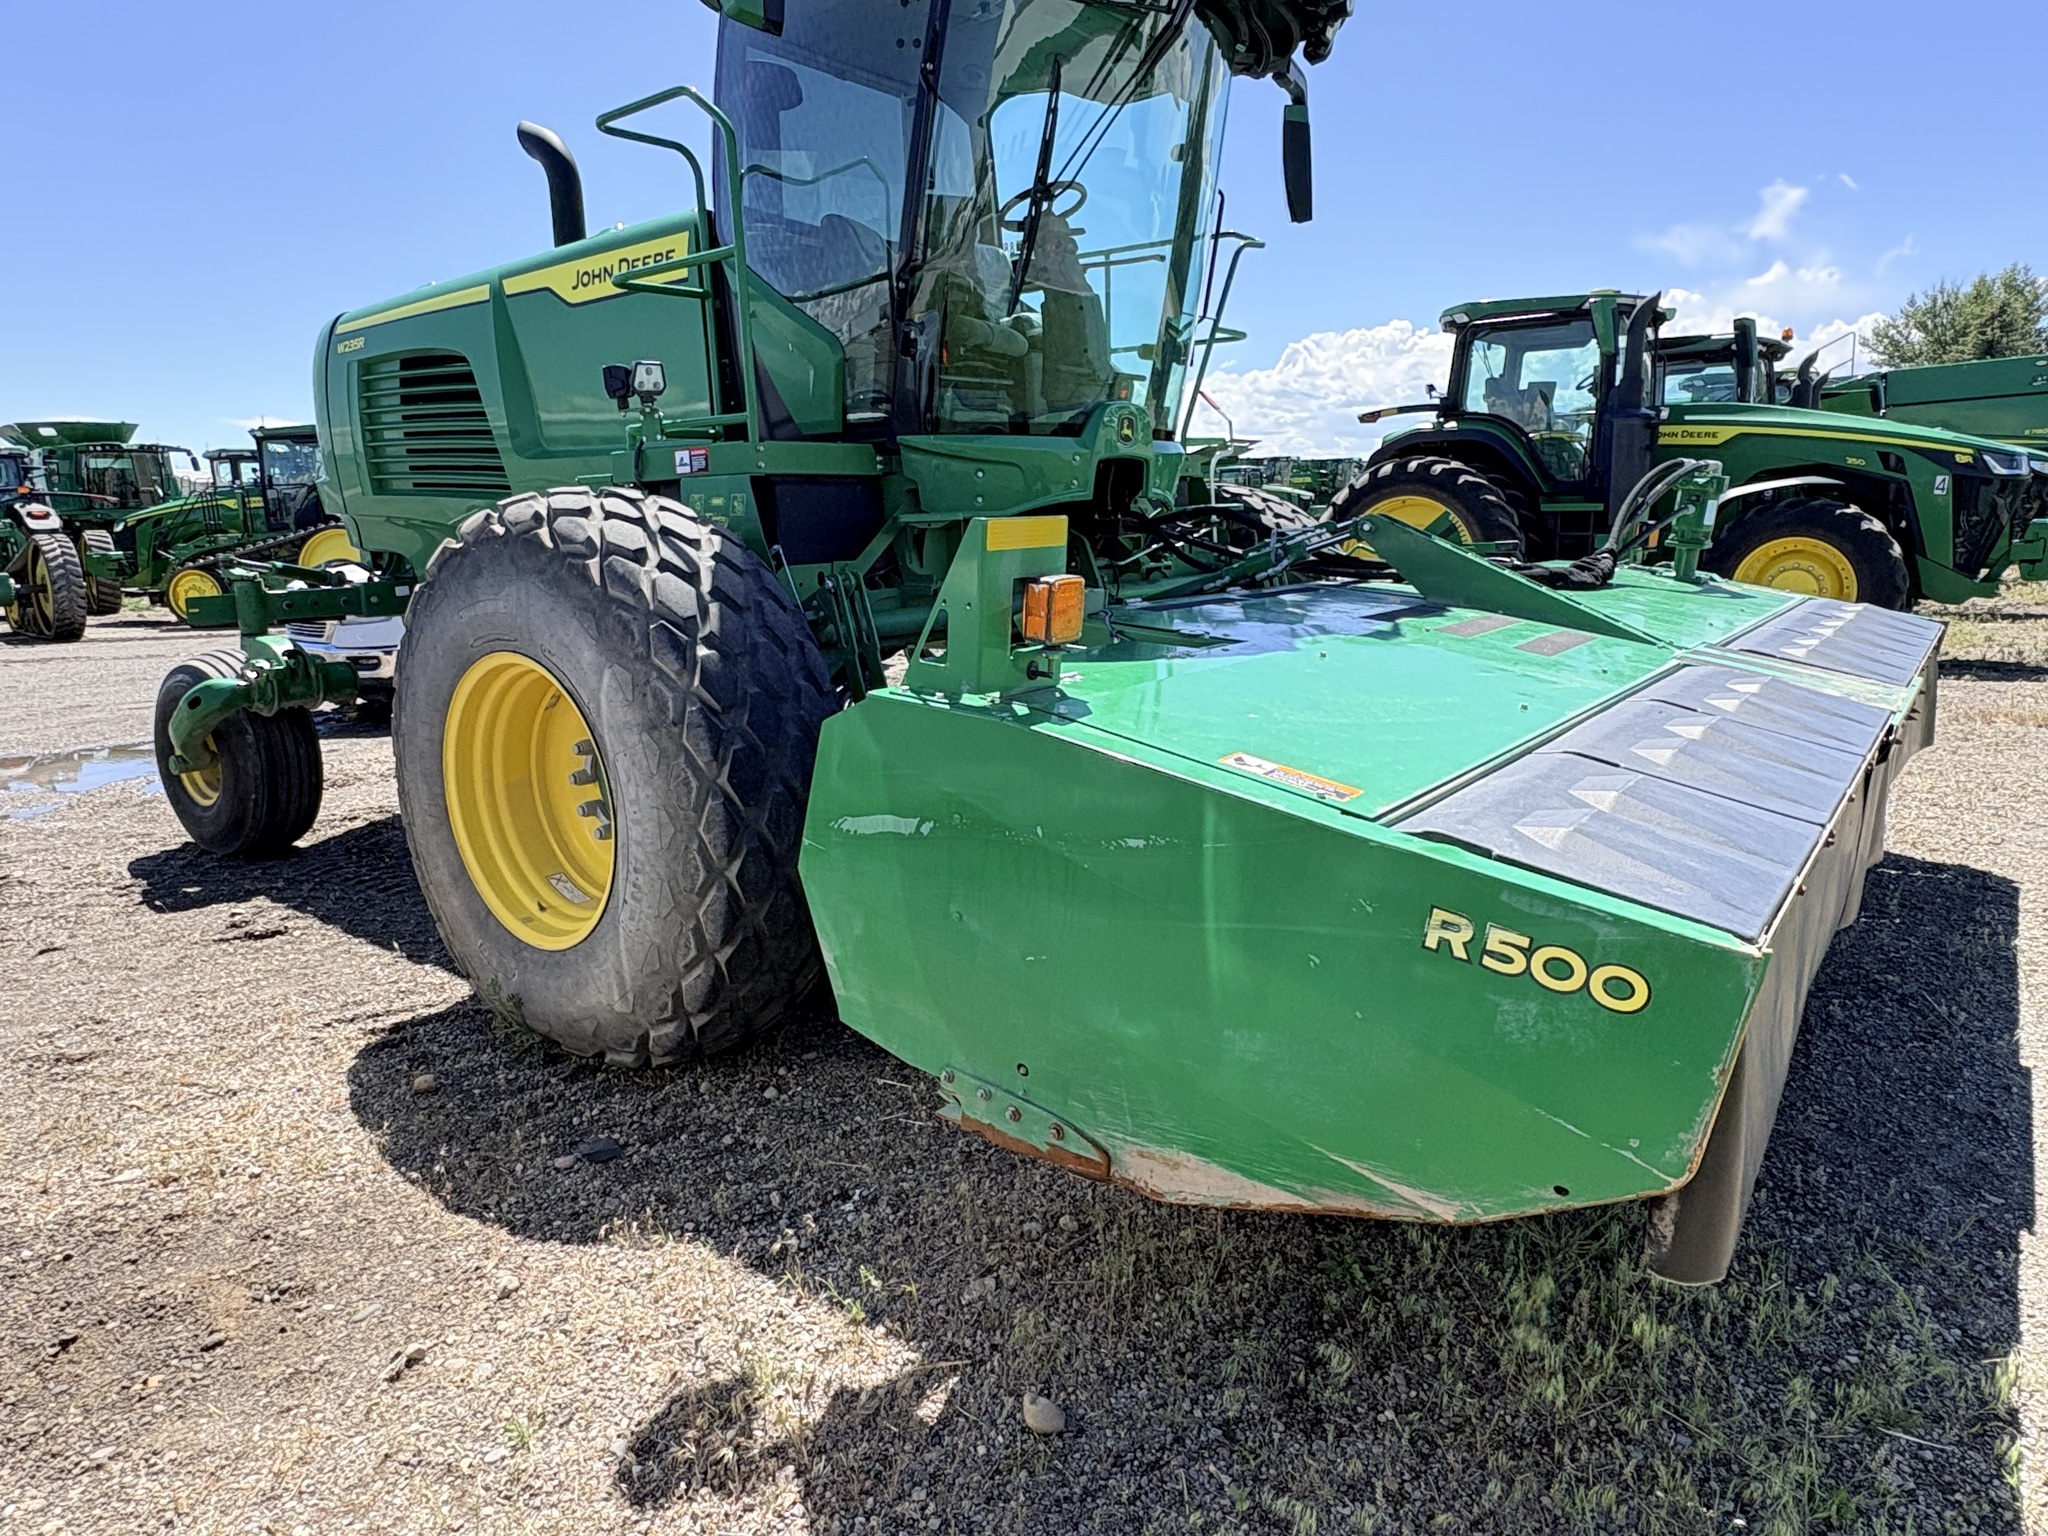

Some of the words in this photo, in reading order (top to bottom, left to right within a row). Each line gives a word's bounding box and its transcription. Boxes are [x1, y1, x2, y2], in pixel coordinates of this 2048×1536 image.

[571, 264, 615, 291] JOHN
[1658, 431, 1679, 439] OHN
[1681, 430, 1719, 439] DEERE
[1935, 476, 1947, 493] 4
